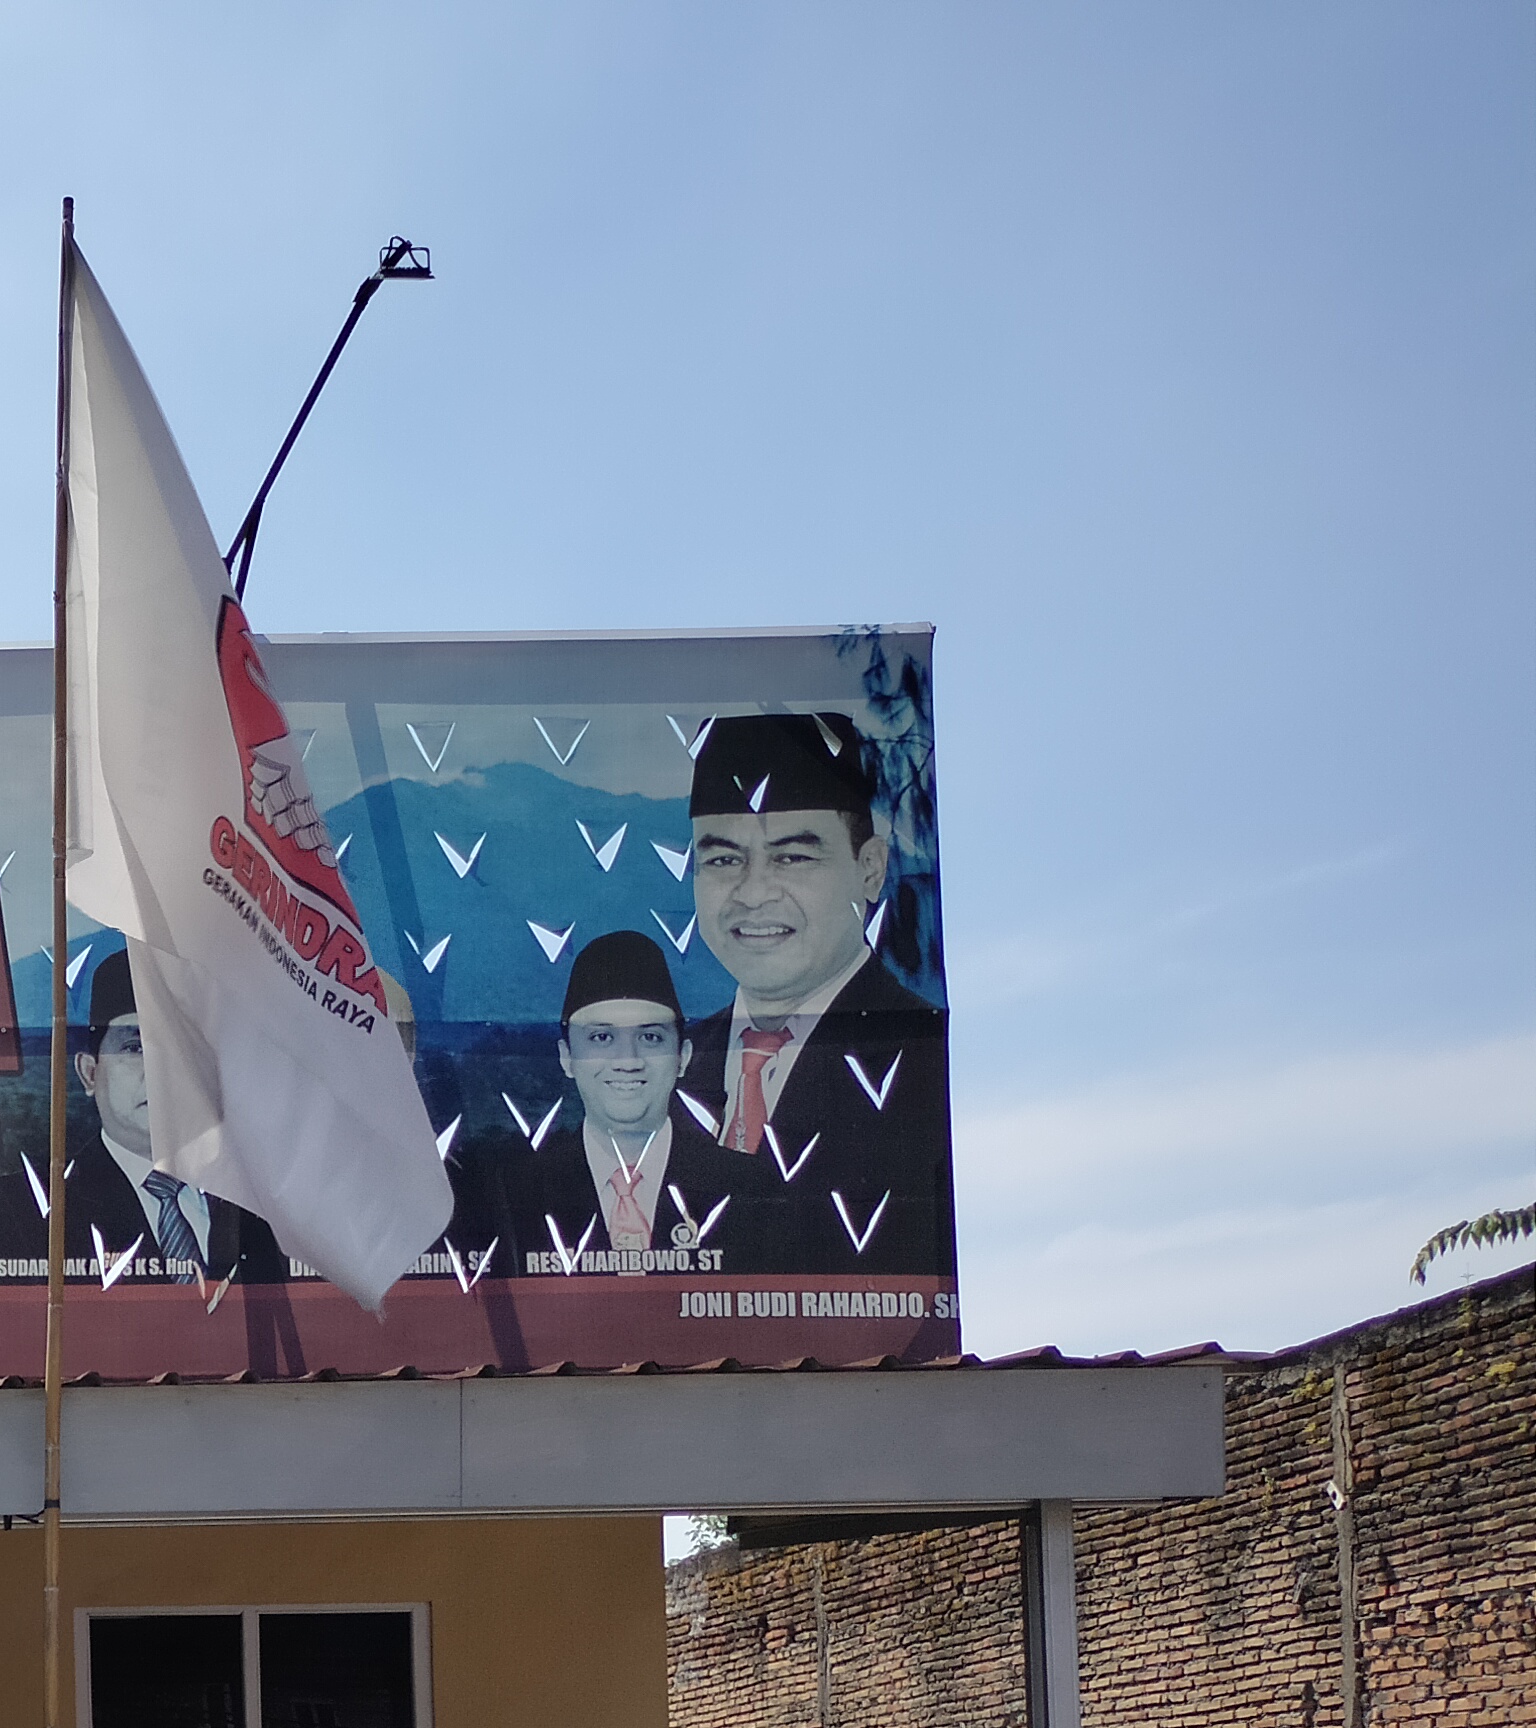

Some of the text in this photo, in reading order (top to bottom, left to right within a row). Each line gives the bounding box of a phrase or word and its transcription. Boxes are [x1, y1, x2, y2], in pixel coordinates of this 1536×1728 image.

[210, 815, 388, 1018] GERINDRA
[321, 990, 376, 1034] RAYA
[581, 1249, 694, 1272] HARIBOWO.
[698, 1249, 724, 1271] ST
[680, 1292, 731, 1318] JONI
[737, 1292, 796, 1318] BUDI
[801, 1292, 930, 1318] RAHARDJO.
